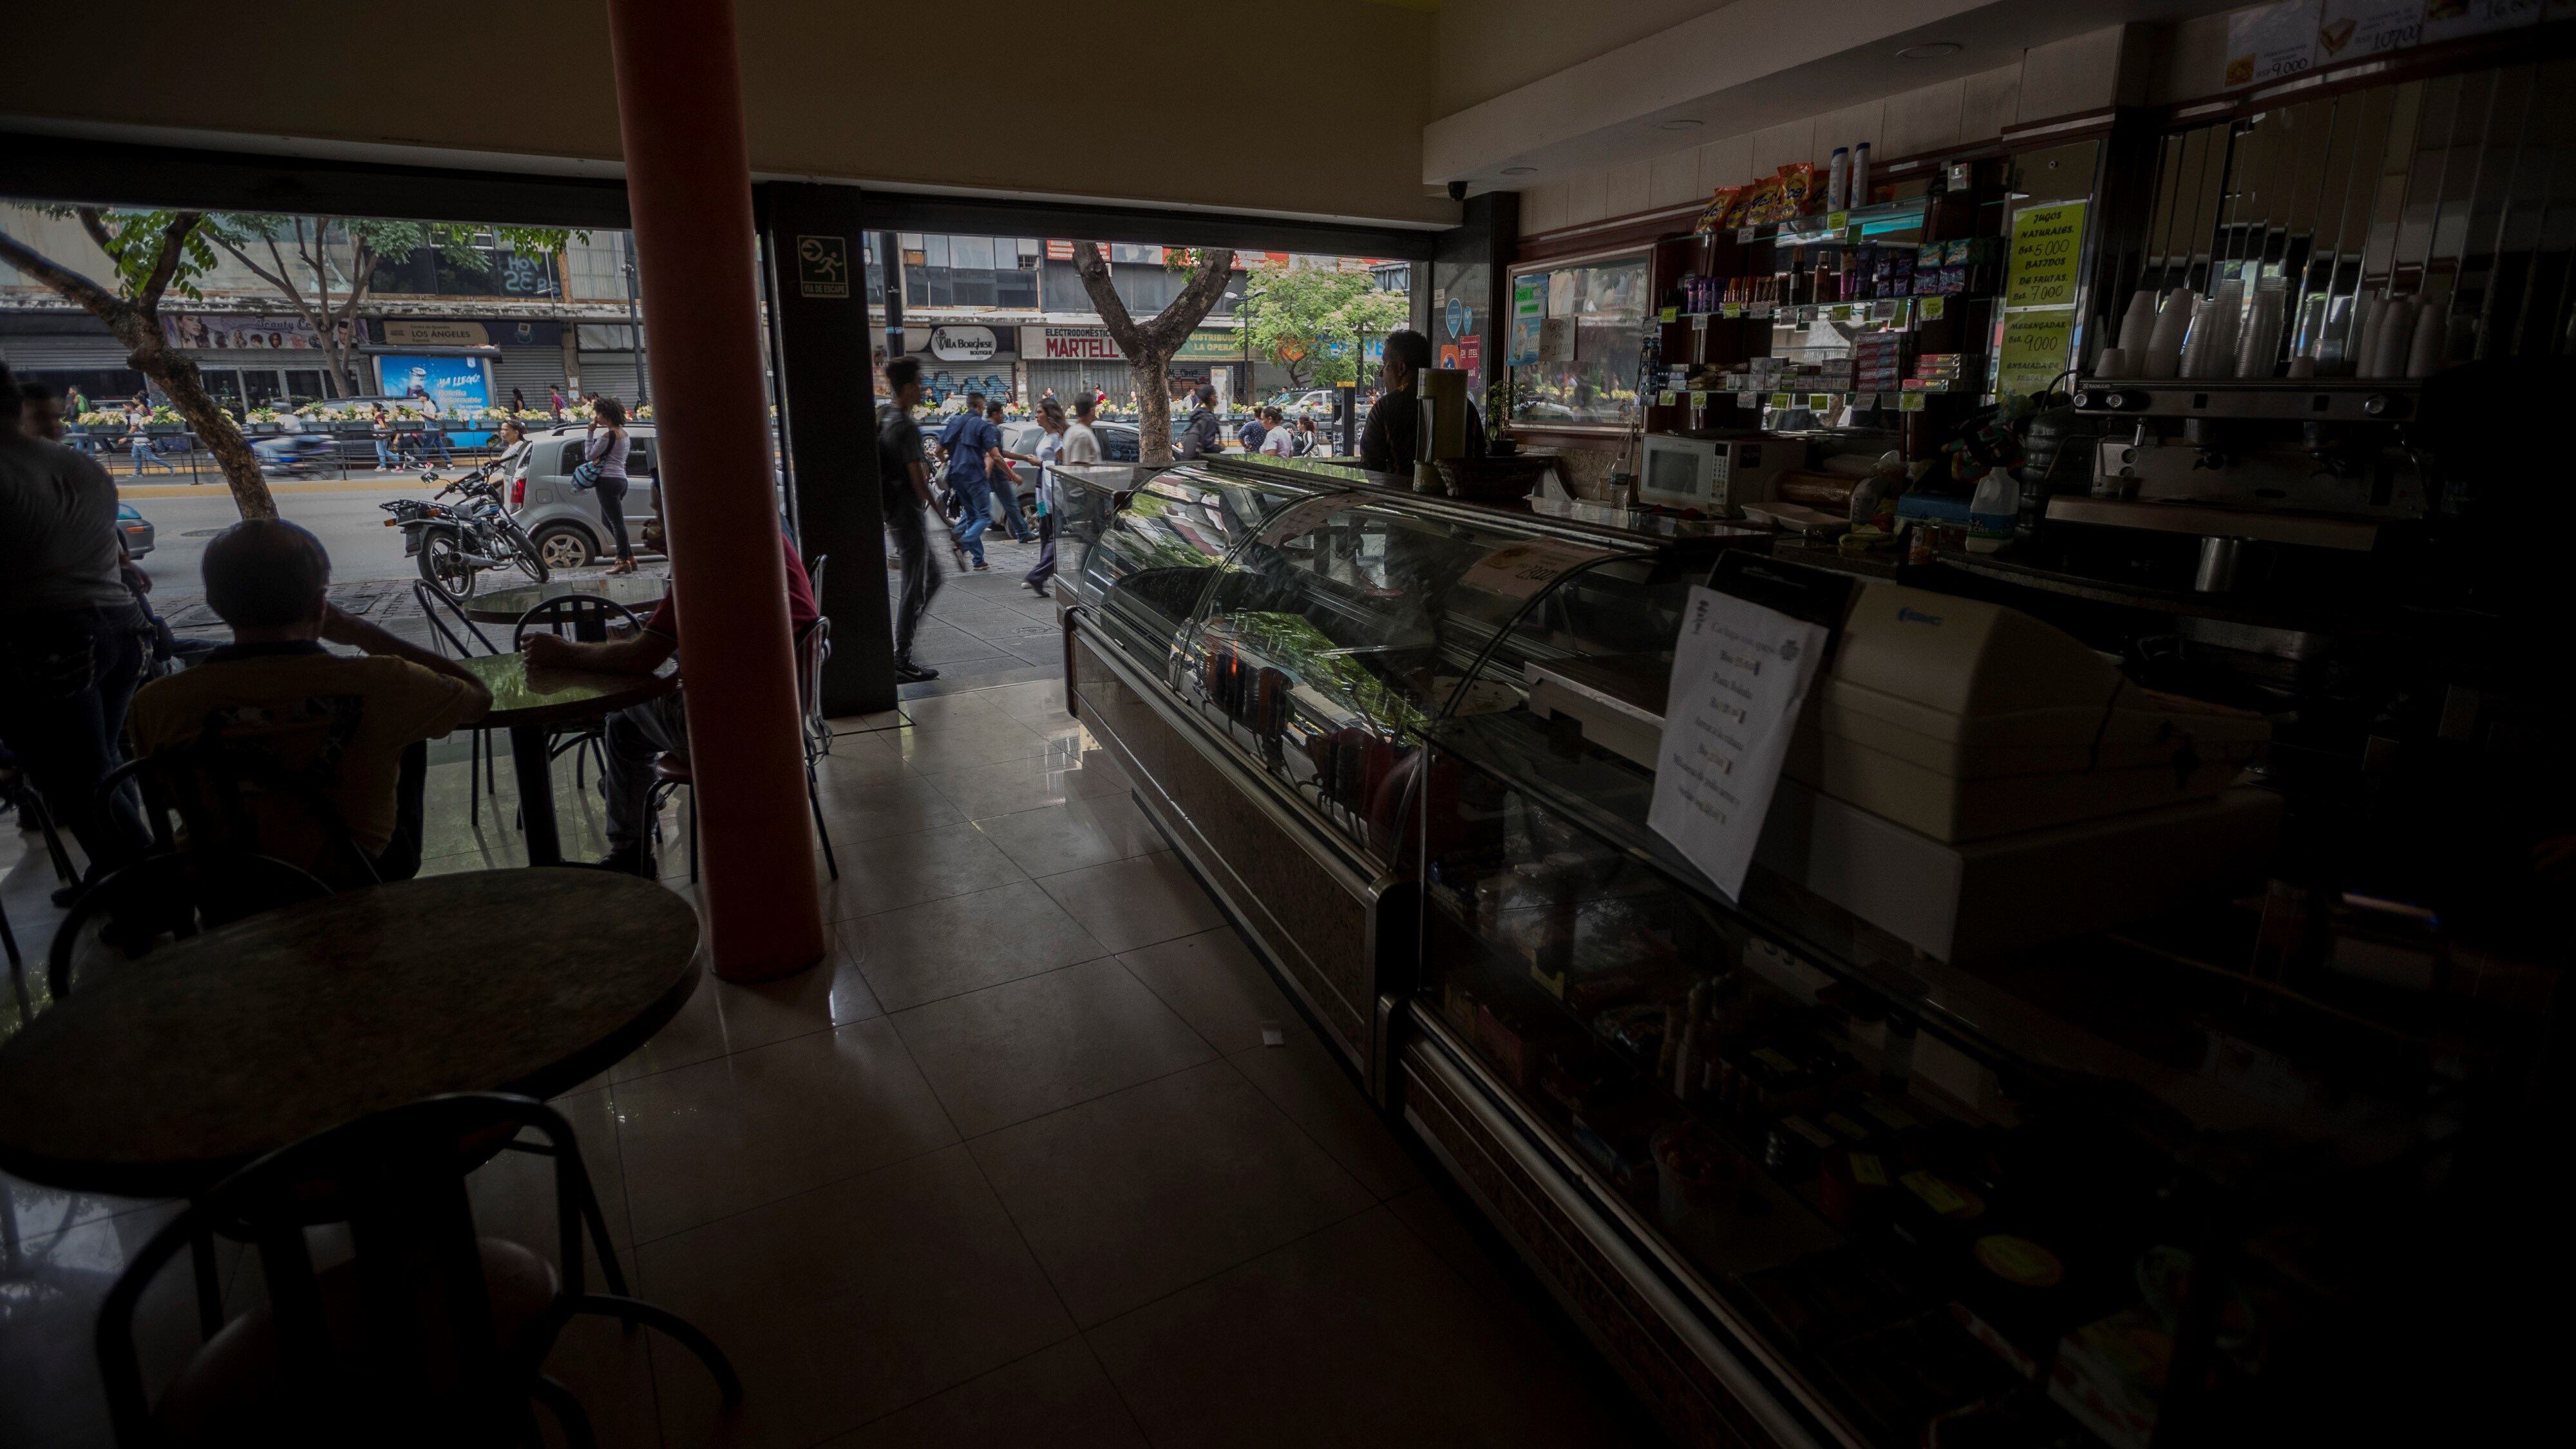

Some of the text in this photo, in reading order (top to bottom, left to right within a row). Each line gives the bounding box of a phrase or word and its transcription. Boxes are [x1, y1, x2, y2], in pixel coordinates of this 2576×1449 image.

[2033, 211, 2062, 224] JUGOS
[2025, 258, 2066, 269] BATIDOS
[2020, 276, 2031, 285] DE
[815, 285, 823, 293] DE
[824, 285, 846, 294] ESCAPE
[1046, 338, 1119, 357] MARTELL
